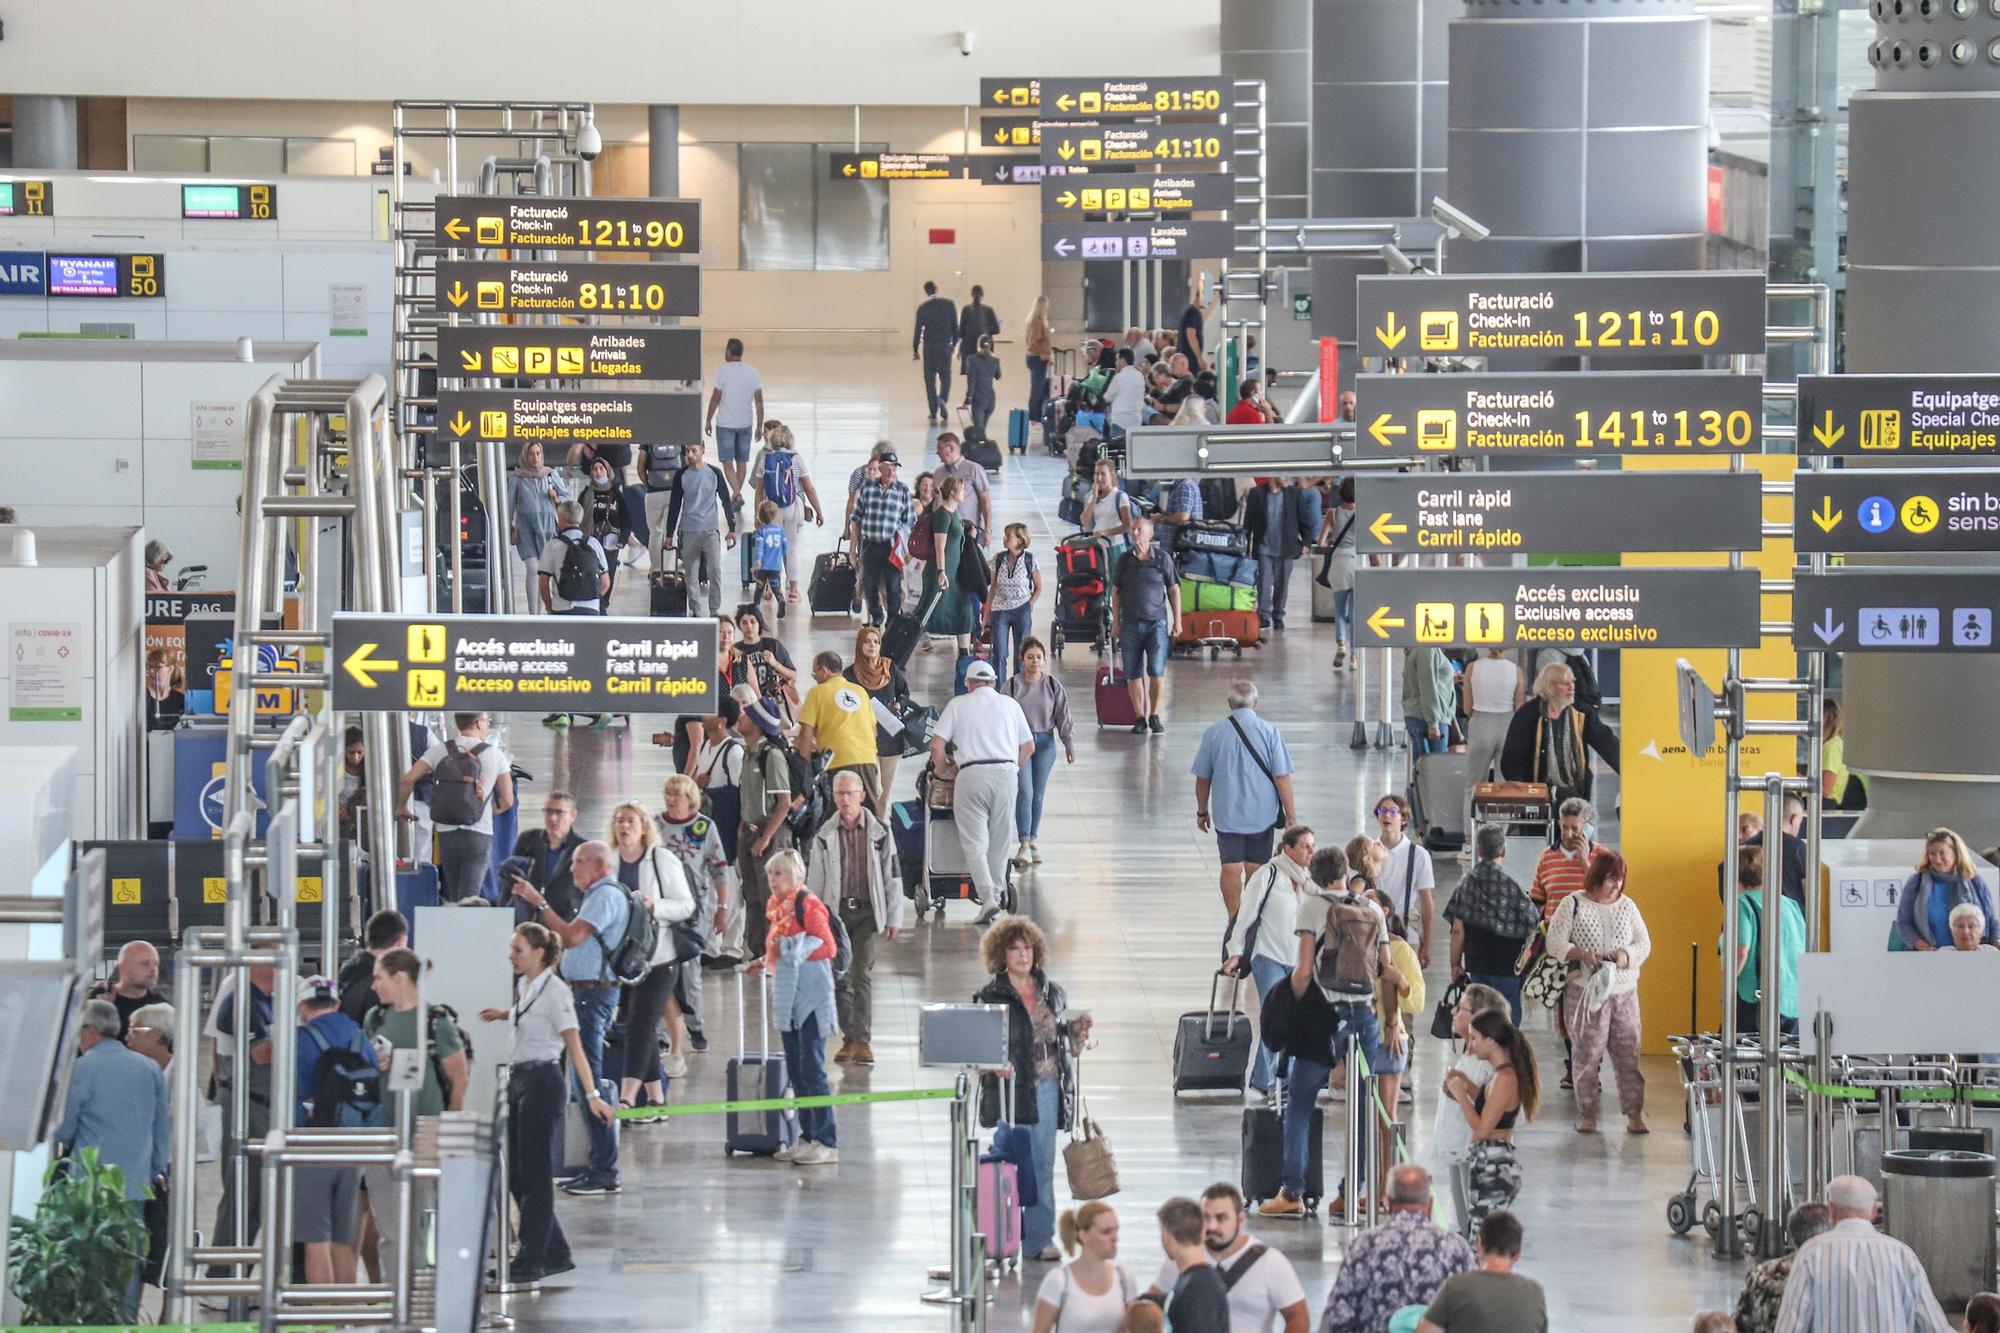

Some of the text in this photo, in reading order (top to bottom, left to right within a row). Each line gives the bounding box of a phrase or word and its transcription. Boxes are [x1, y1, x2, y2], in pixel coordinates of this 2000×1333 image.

[1103, 82, 1148, 92] Facturació
[1103, 102, 1153, 111] Facturación
[1154, 90, 1181, 111] 81
[1191, 90, 1220, 110] 50
[1104, 130, 1148, 140] Facturació
[1103, 150, 1153, 159] Facturación
[1154, 138, 1181, 159] 41
[1192, 138, 1220, 159] 10
[27, 201, 44, 216] 11
[251, 204, 270, 218] 10
[510, 205, 569, 219] Facturació
[511, 219, 553, 231] Check-in
[1151, 227, 1187, 237] Lavabos
[510, 232, 575, 245] Facturación
[578, 219, 684, 248] 121 to 90
[633, 237, 641, 247] a
[59, 260, 115, 268] RYANAIR
[510, 270, 569, 283] Facturació
[130, 277, 157, 296] 50
[511, 283, 553, 295] Check-in
[510, 296, 575, 309] Facturación
[578, 283, 665, 310] 81 to 10
[1468, 293, 1554, 309] Facturació
[617, 300, 625, 310] a
[1468, 312, 1531, 328] Check-in
[1573, 310, 1720, 347] 121 to 10
[590, 335, 646, 348] Arribades
[1468, 330, 1564, 347] Facturación
[1651, 332, 1661, 346] a
[590, 349, 626, 360] Arrivals
[591, 362, 642, 376] Llegadas
[513, 399, 633, 414] Equipatges especials
[1467, 391, 1555, 409] Facturació
[1911, 390, 2000, 411] Equipatge
[513, 412, 593, 425] Special check-in
[1467, 412, 1531, 428] Check-in
[1911, 411, 2000, 429] Special Che
[513, 425, 632, 440] Equipajes especiales
[1574, 410, 1753, 448] 141 to 130
[1467, 430, 1565, 448] Facturación
[1654, 433, 1665, 446] a
[1911, 431, 1996, 451] Equipajes
[1417, 488, 1512, 511] Carril ràpid
[1948, 491, 2000, 511] sin b
[1419, 511, 1484, 527] Fast lane
[1948, 516, 2000, 531] sens
[1417, 529, 1522, 551] Carril rápido
[1515, 584, 1640, 602] Accés exclusiu
[191, 603, 221, 613] BAG
[1515, 605, 1634, 621] Exclusive access
[1515, 624, 1658, 642] Acceso exclusivo
[455, 638, 576, 657] Accés exclusiu
[606, 639, 699, 661] Carril ràpid
[454, 657, 568, 674] Exclusive access
[606, 659, 669, 674] Fast lane
[455, 675, 592, 694] Acceso exclusivo
[606, 676, 708, 697] Carril rápido
[1662, 745, 1686, 754] aena
[1717, 745, 1761, 754] beras
